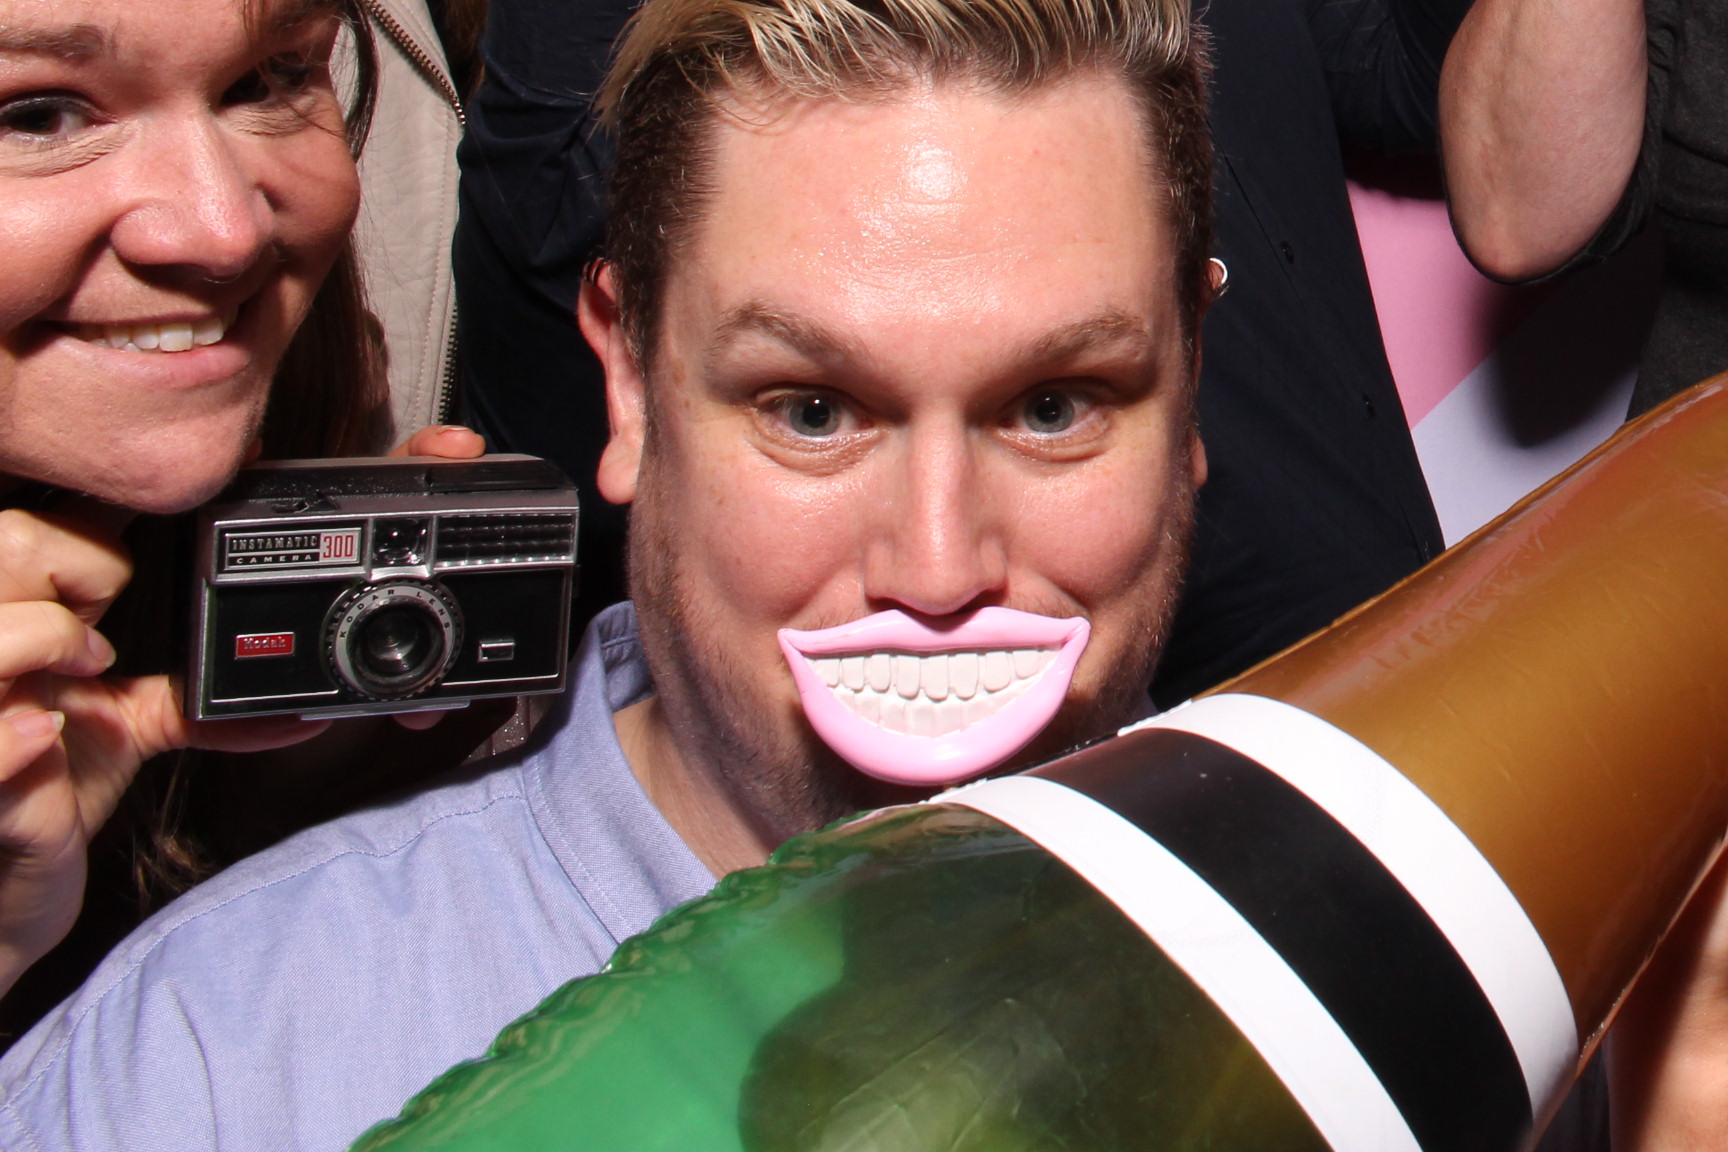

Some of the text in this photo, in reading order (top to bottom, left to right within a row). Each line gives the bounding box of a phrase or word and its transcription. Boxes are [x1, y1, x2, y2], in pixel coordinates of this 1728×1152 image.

[232, 534, 354, 558] INSTAMATIC 300
[236, 554, 312, 564] CAMERA
[339, 589, 451, 638] KODAR LENS
[243, 636, 287, 649] Kodak
